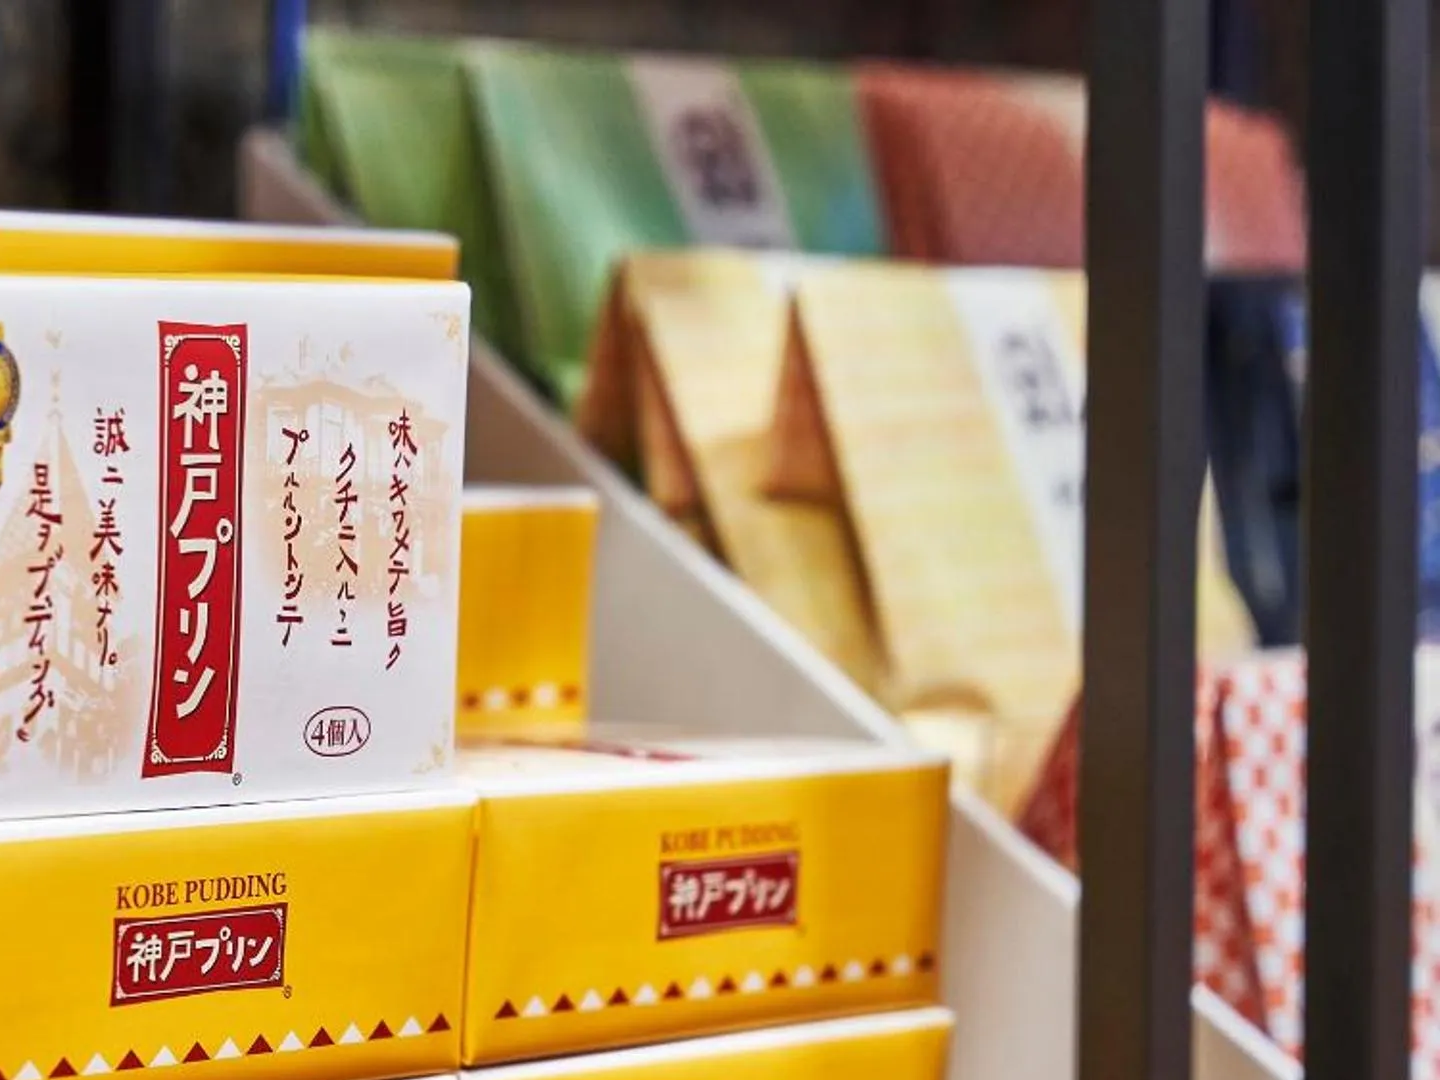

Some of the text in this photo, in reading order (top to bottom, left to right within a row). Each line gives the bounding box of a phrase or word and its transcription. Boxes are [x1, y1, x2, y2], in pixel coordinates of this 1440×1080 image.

[171, 363, 233, 719] 神戸プリン
[116, 872, 288, 910] KOBE PUDDING
[668, 867, 791, 921] 神戸プリン
[126, 926, 273, 983] 神戸プリン
